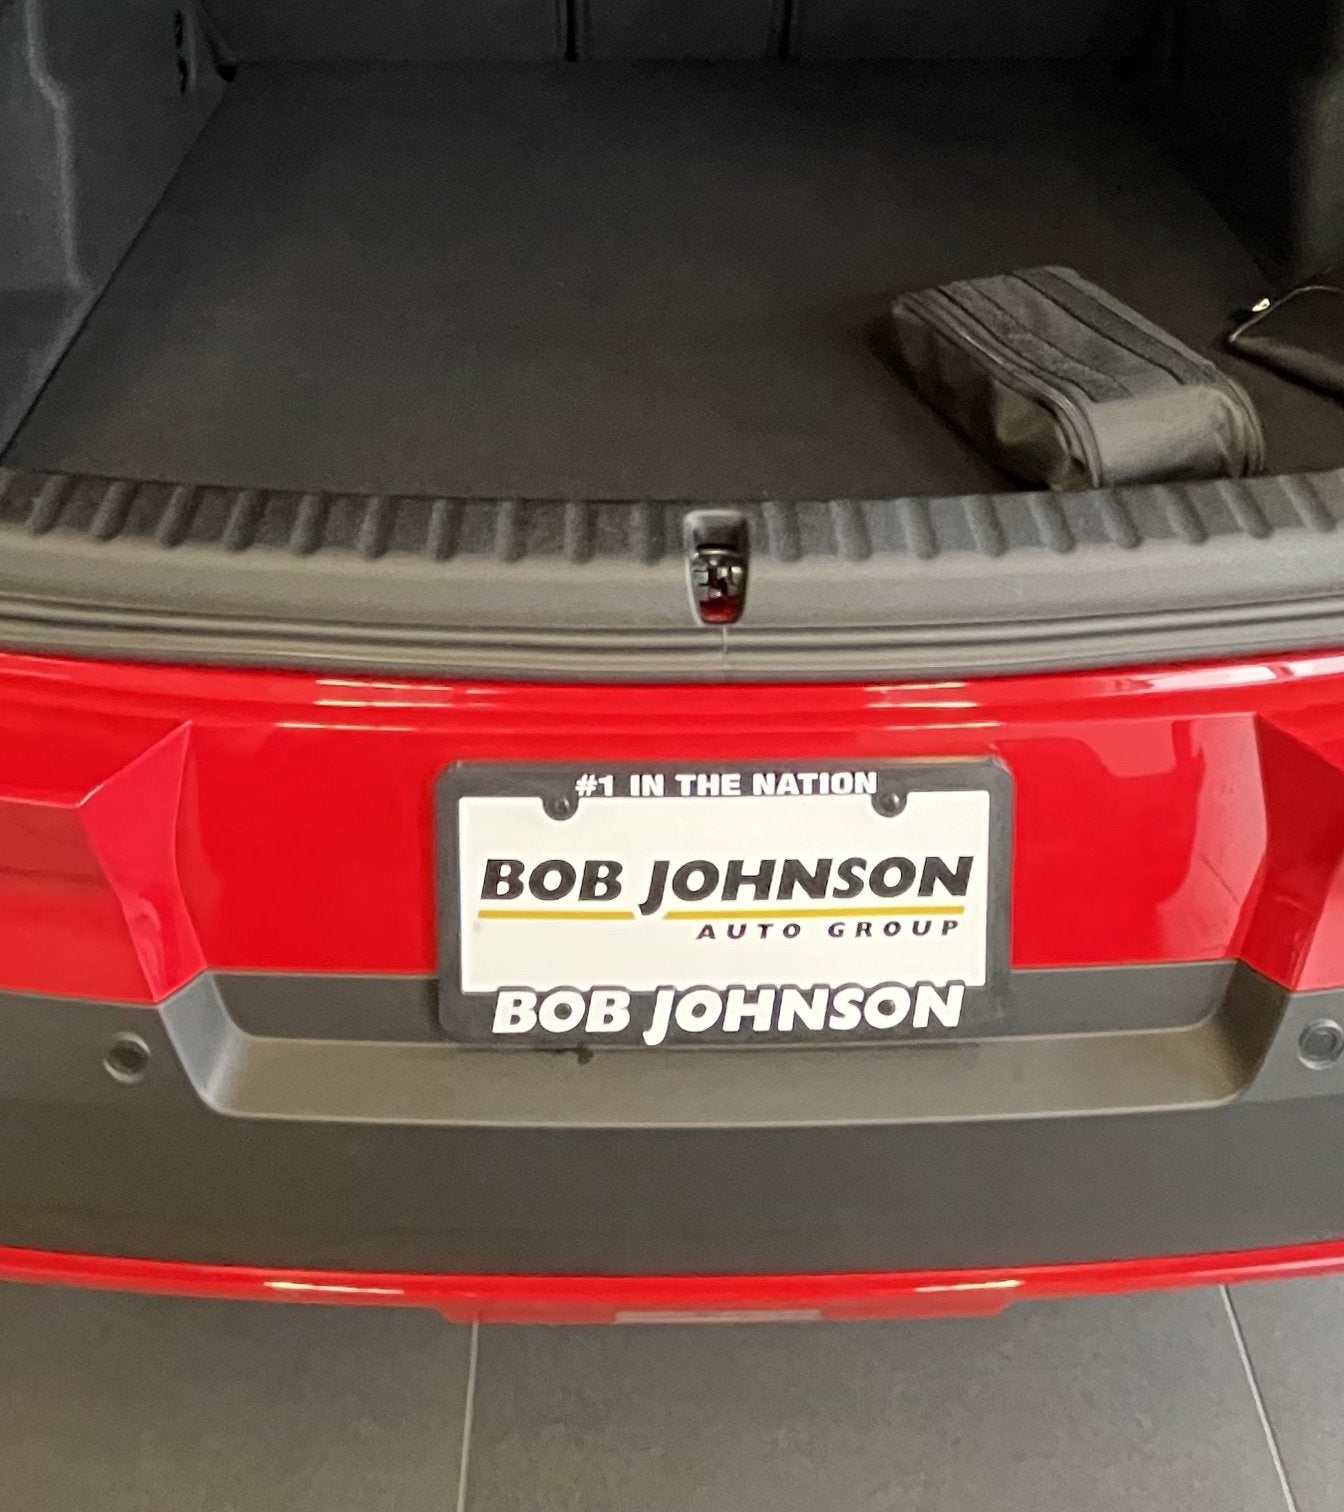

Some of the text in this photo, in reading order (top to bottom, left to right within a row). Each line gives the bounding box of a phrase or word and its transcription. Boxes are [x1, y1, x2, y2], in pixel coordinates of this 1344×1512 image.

[575, 772, 877, 796] #1 IN THE NATION
[481, 856, 973, 915] BOB JOHNSON
[696, 920, 960, 940] AUTO GROUP
[492, 984, 963, 1046] BOB JOHNSON
